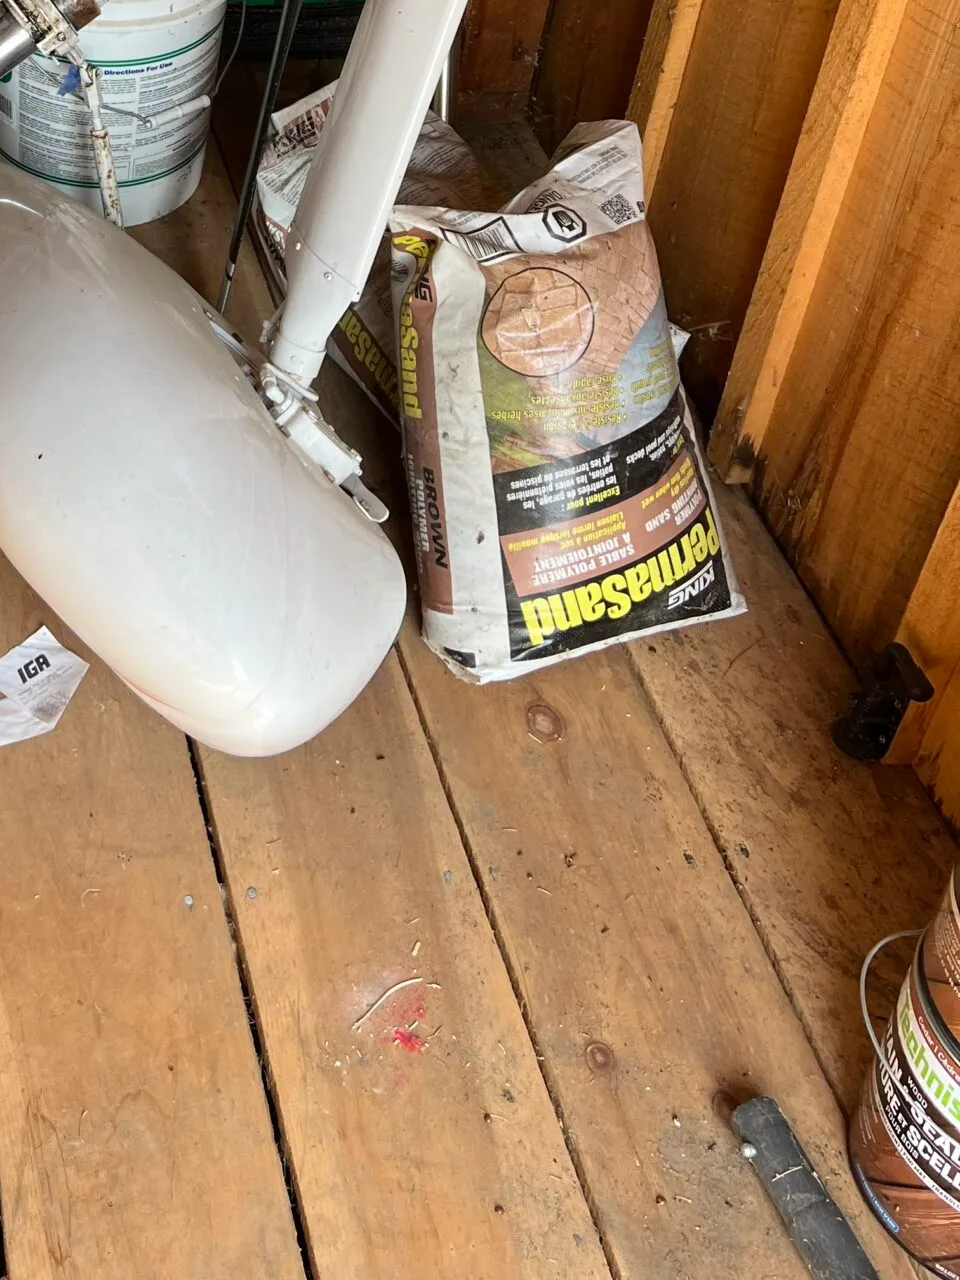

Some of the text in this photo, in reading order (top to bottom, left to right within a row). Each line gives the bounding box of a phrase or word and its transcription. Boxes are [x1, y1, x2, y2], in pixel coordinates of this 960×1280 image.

[103, 61, 173, 76] Directions For Use
[596, 372, 617, 387] Prise
[490, 409, 521, 420] herbes
[589, 457, 601, 469] les
[625, 447, 646, 465] decks
[509, 472, 542, 490] piscines
[542, 471, 554, 483] de
[553, 462, 589, 481] terrasses
[574, 473, 588, 485] les
[587, 462, 614, 478] patios,
[522, 474, 617, 510] les entrées de garage, les
[583, 485, 620, 507] Excellent
[639, 494, 656, 509] wet
[415, 478, 429, 552] POLYMER
[564, 496, 584, 512] pour
[673, 488, 702, 525] POLYMER
[422, 466, 447, 569] BROWN
[594, 509, 624, 527] Liaison
[643, 507, 672, 532] SAND
[581, 519, 627, 542] Application
[558, 537, 574, 549] sec
[532, 536, 620, 574] JOINTOIEMENT
[597, 543, 636, 567] SABLE
[518, 506, 722, 646] PermaSand
[667, 568, 713, 610] KING
[16, 653, 51, 684] IGA
[917, 1015, 935, 1047] Cedar
[886, 1024, 902, 1078] TAIN
[905, 1075, 929, 1109] WOOD
[884, 1104, 920, 1159] POUR BOIS
[898, 1113, 908, 1128] ET
